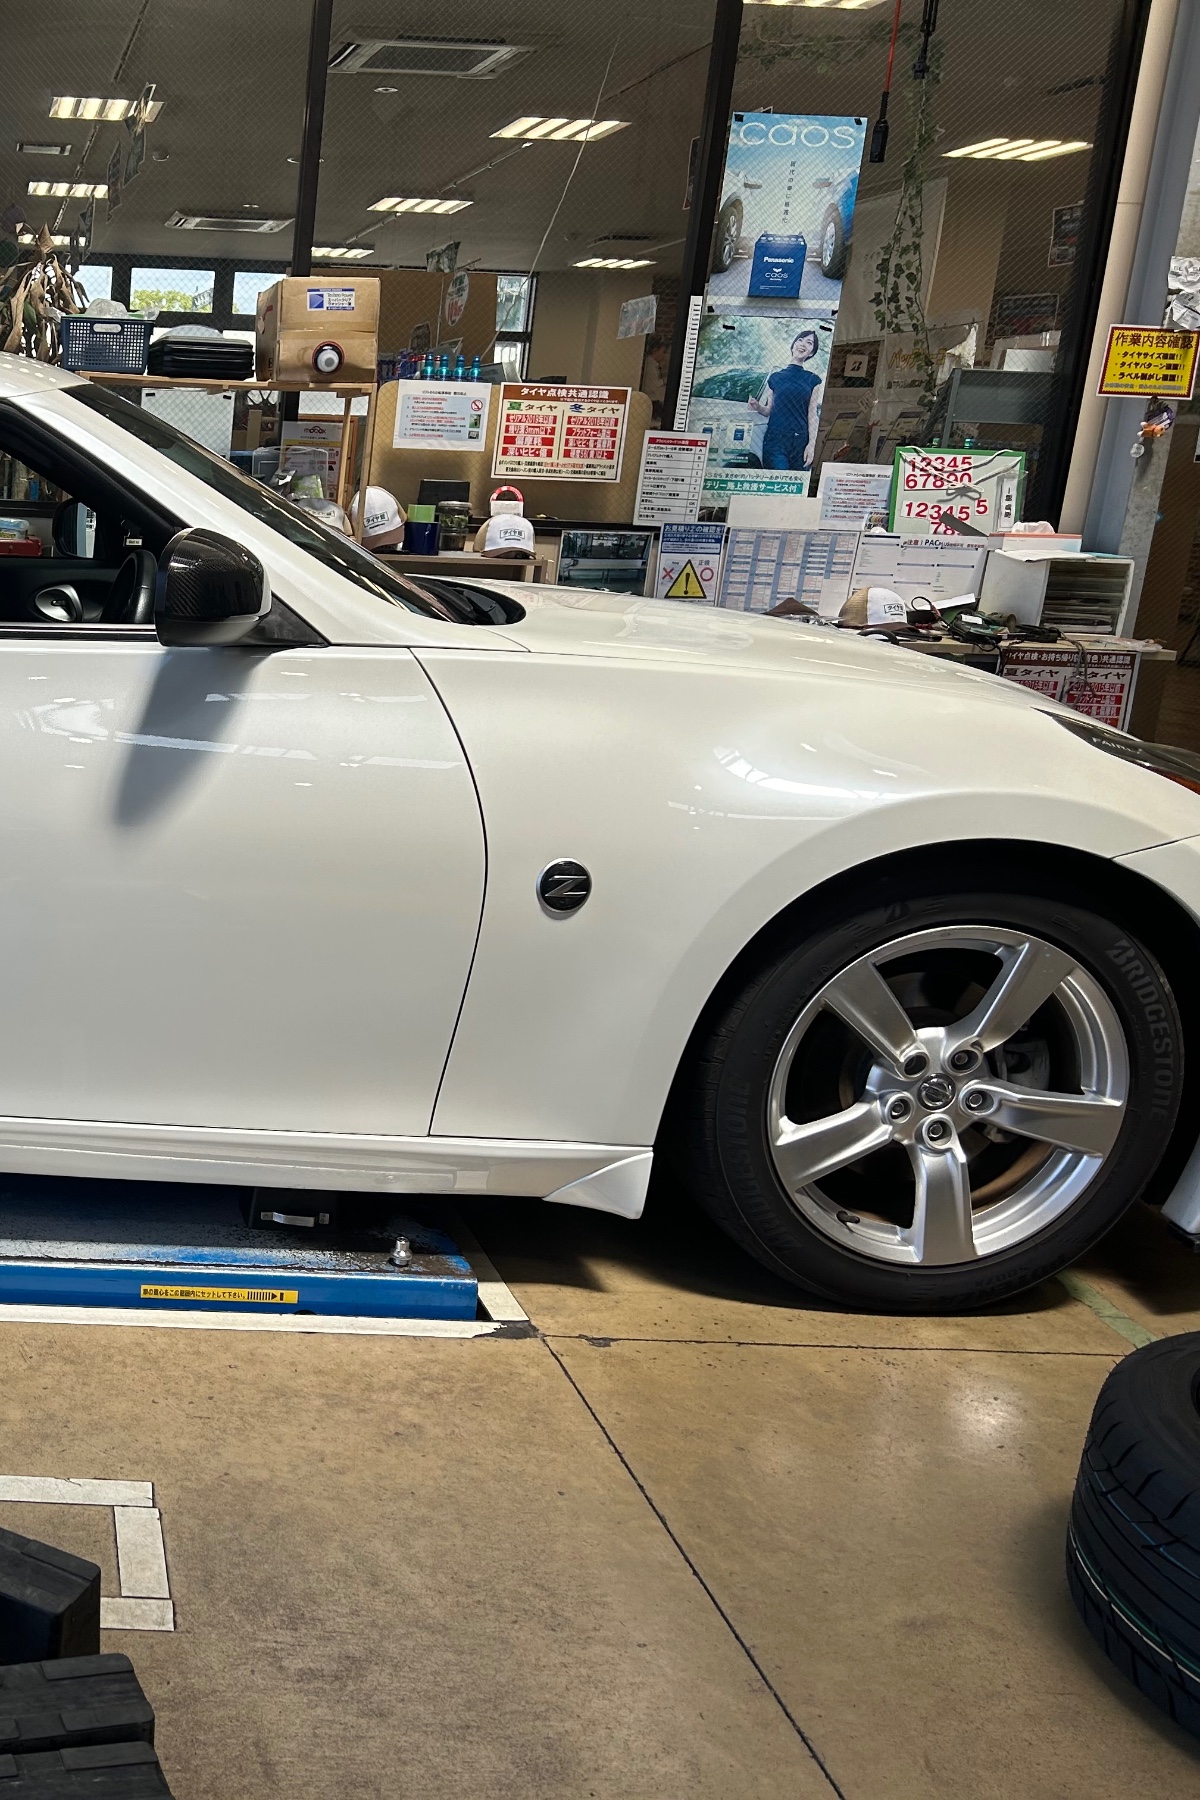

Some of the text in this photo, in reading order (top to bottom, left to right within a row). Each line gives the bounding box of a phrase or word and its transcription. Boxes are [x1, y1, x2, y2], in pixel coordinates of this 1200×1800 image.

[740, 122, 855, 149] caos
[763, 256, 795, 264] Panasonic
[1115, 332, 1194, 350] 作業内容確認
[521, 387, 609, 400] タイヤ点検共通認識
[507, 401, 558, 412] 夏タイヤ
[569, 403, 621, 415] 冬タイヤ
[545, 875, 587, 897] Z
[1104, 938, 1175, 1121] BRIDGESTONE
[143, 1288, 246, 1299] 車の重心をこの範囲内にセットして下さい。
